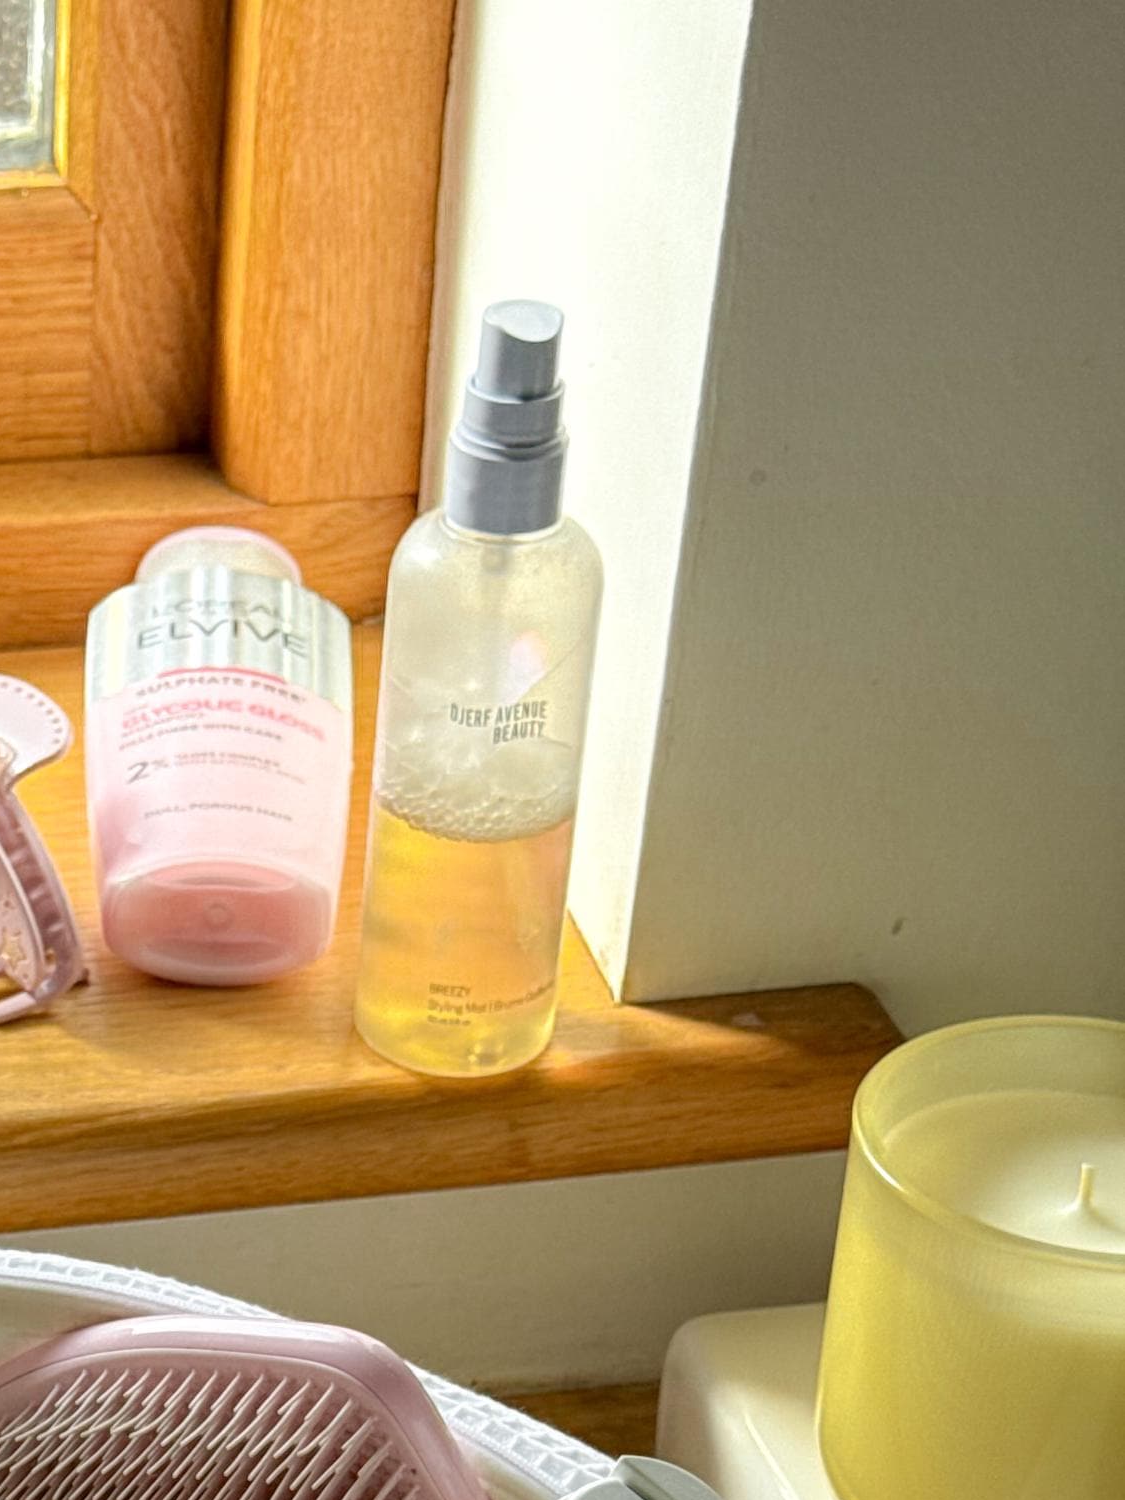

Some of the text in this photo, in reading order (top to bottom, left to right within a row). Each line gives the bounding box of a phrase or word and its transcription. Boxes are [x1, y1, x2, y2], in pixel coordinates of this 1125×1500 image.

[137, 619, 308, 659] ELVIVE
[135, 676, 244, 698] SULPHATE
[450, 700, 548, 728] DJERF AVENUE
[492, 720, 545, 745] BEAUTY
